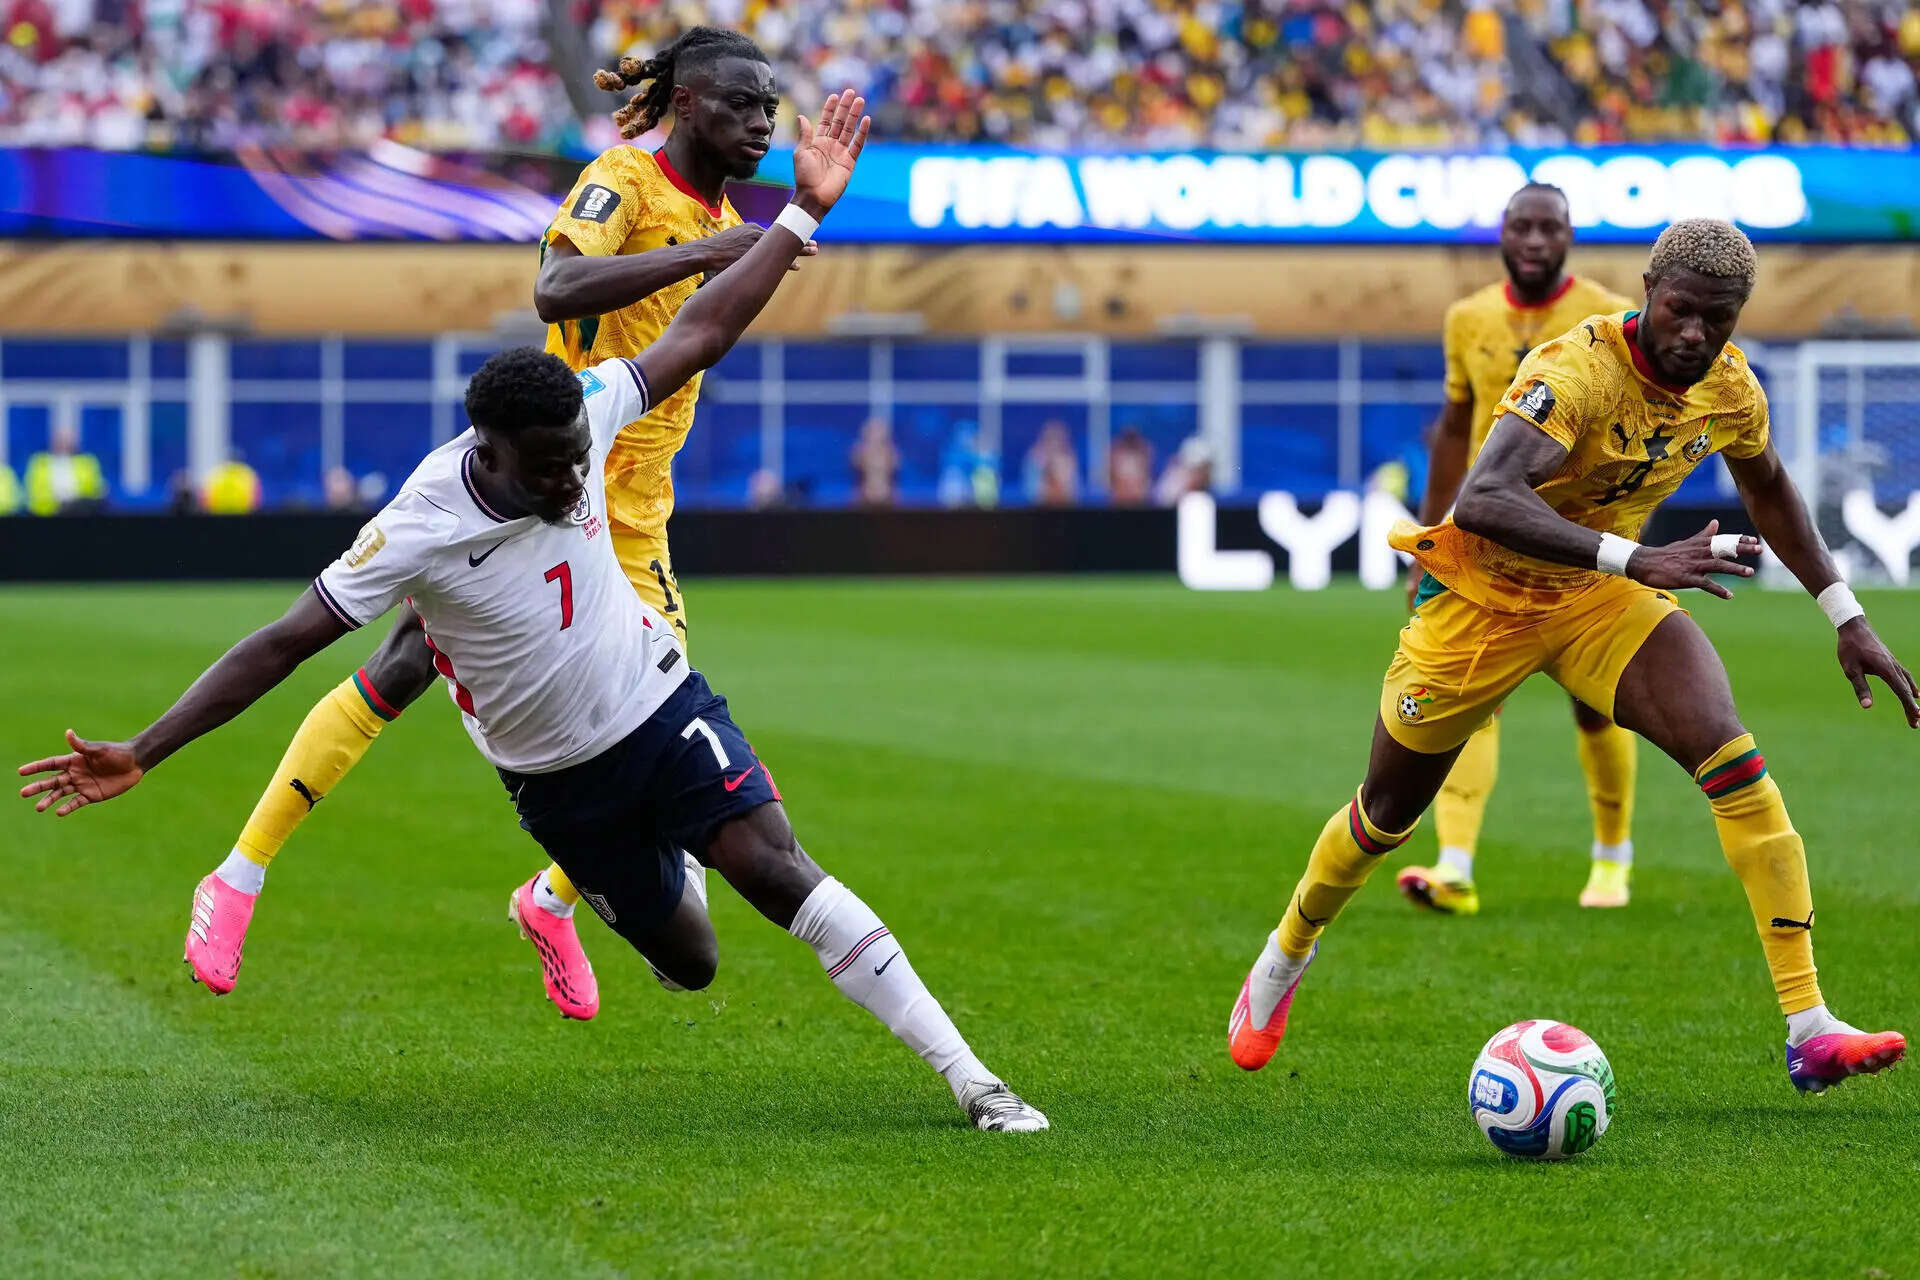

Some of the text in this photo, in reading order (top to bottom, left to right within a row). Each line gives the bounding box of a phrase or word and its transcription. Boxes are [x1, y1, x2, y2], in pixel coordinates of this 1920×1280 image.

[909, 156, 1083, 228] FIFA
[1077, 155, 1365, 229] WORLD
[1367, 155, 1528, 229] CUP
[544, 560, 574, 631] 7
[681, 716, 731, 770] 7
